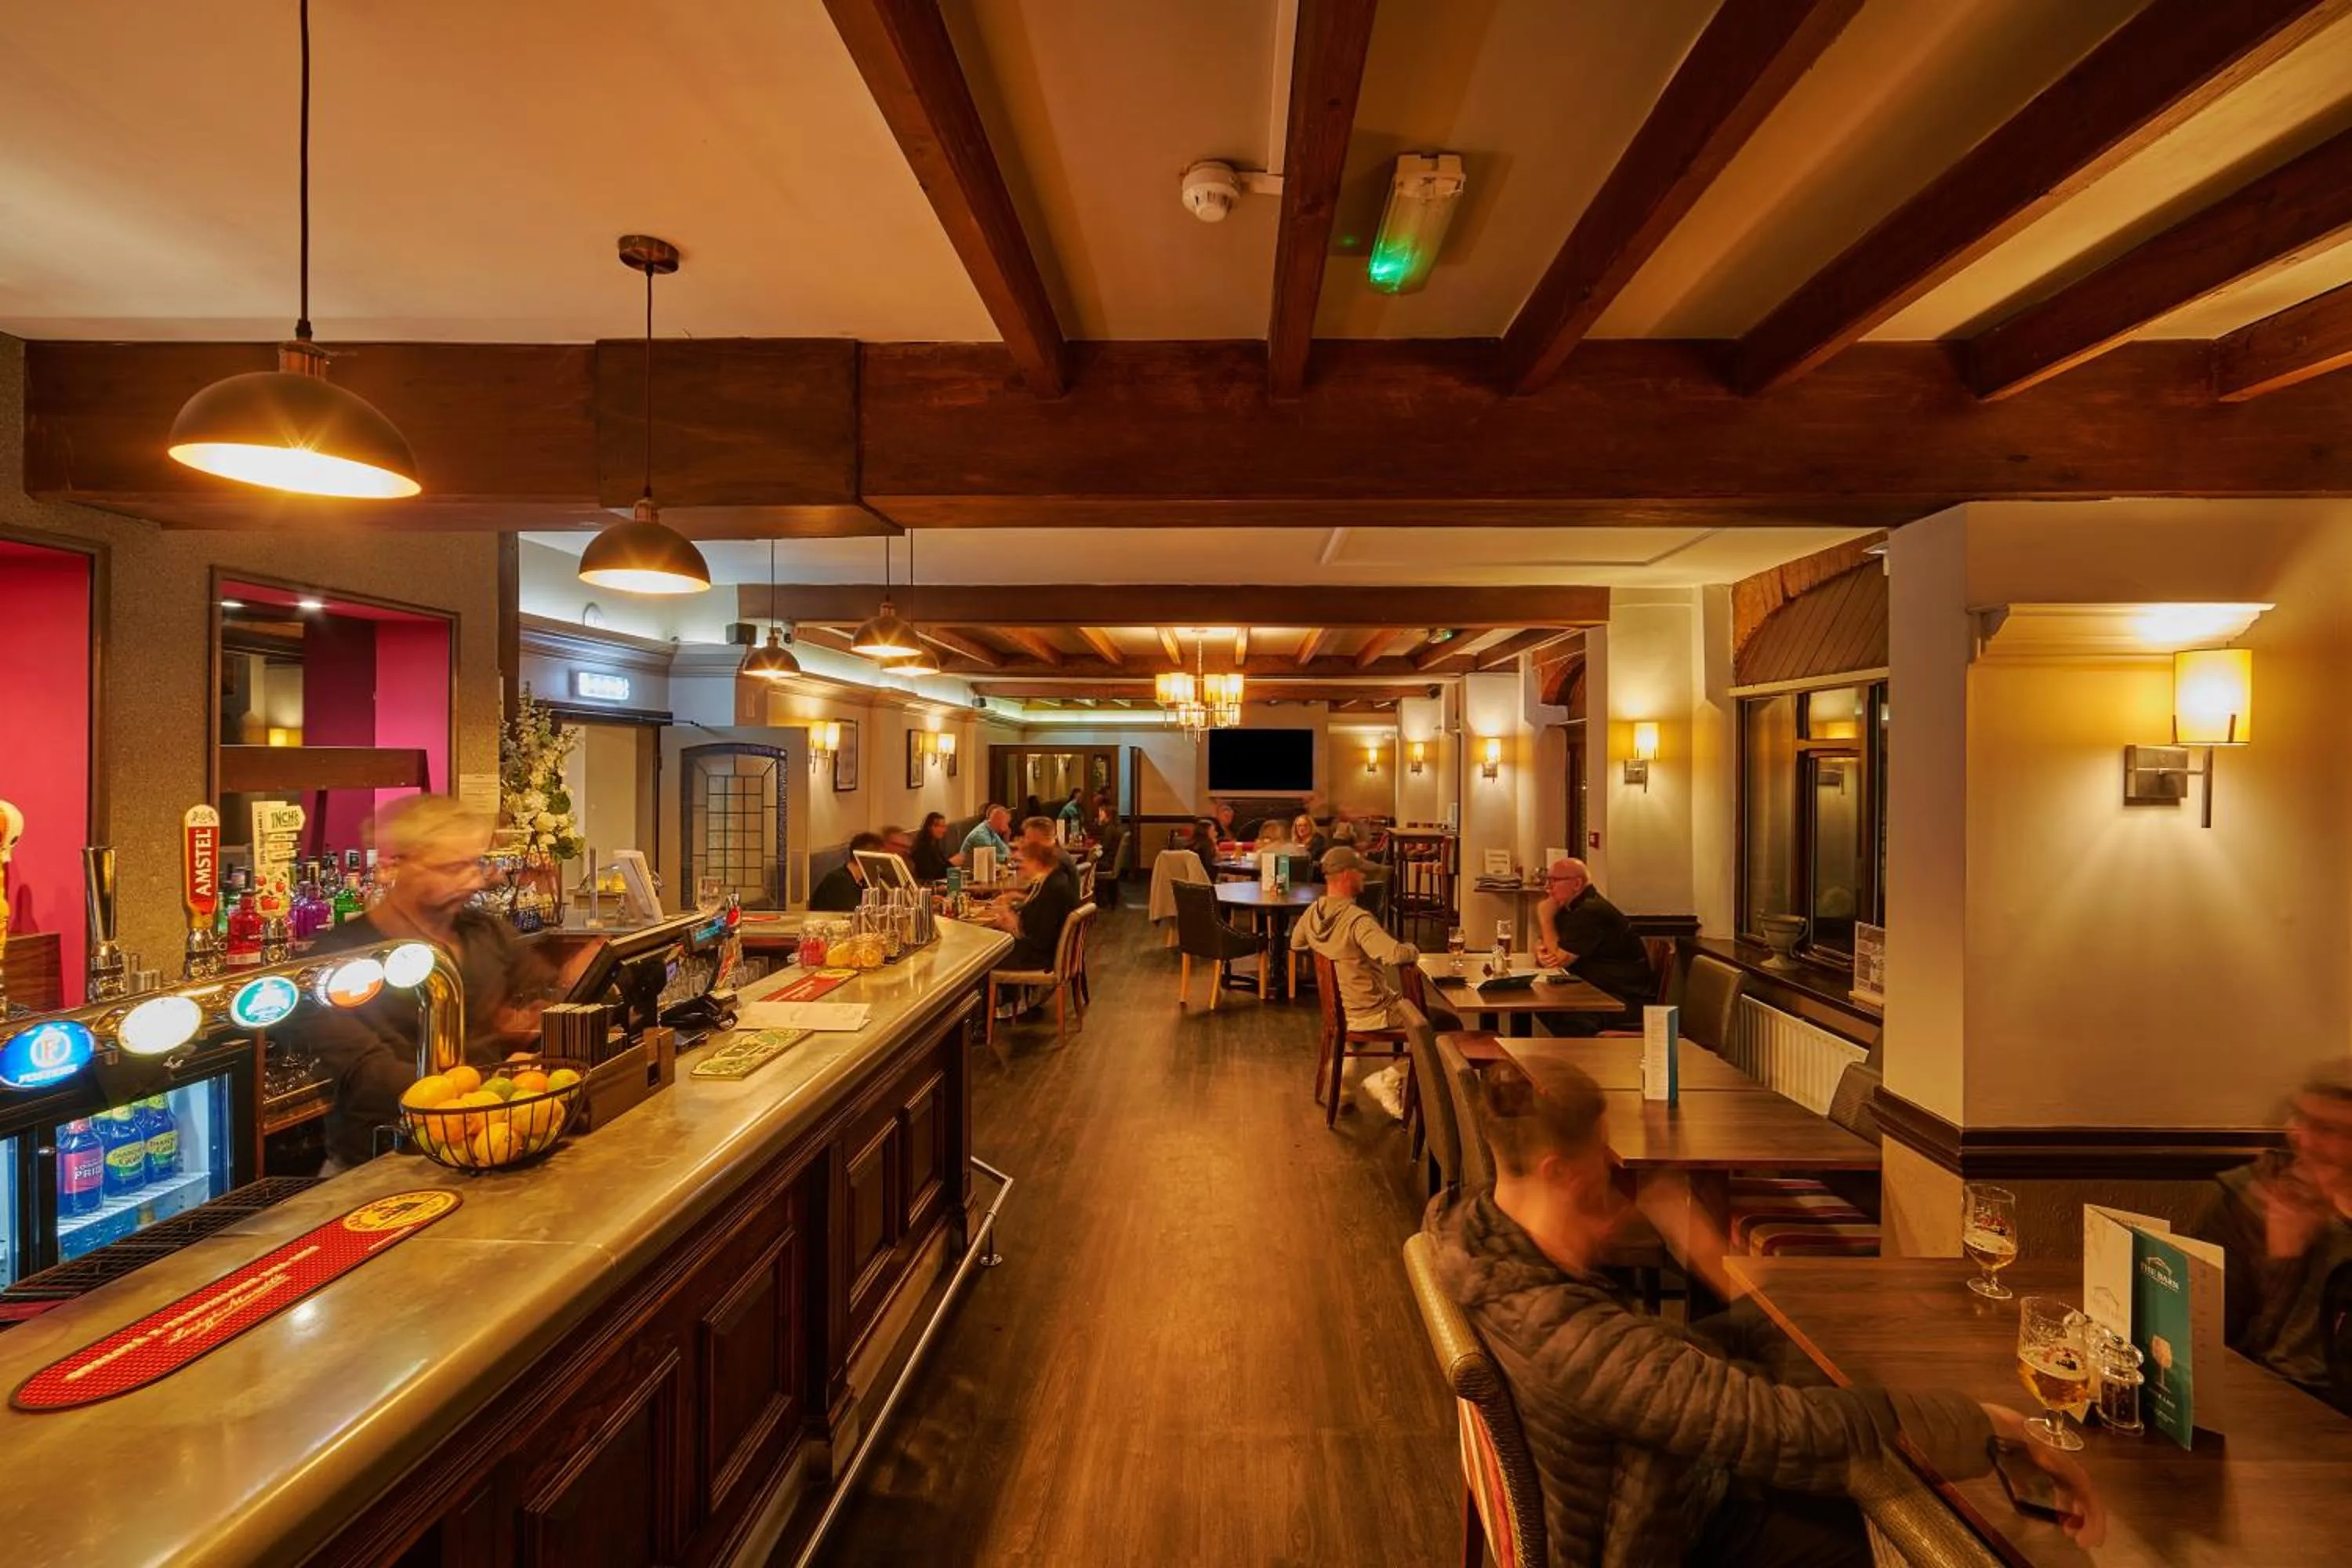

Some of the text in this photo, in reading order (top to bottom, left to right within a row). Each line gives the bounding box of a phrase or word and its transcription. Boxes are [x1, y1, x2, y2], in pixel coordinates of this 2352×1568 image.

[270, 810, 299, 829] INCH'S
[195, 829, 212, 896] AMSTEL
[2157, 1272, 2180, 1289] BARN
